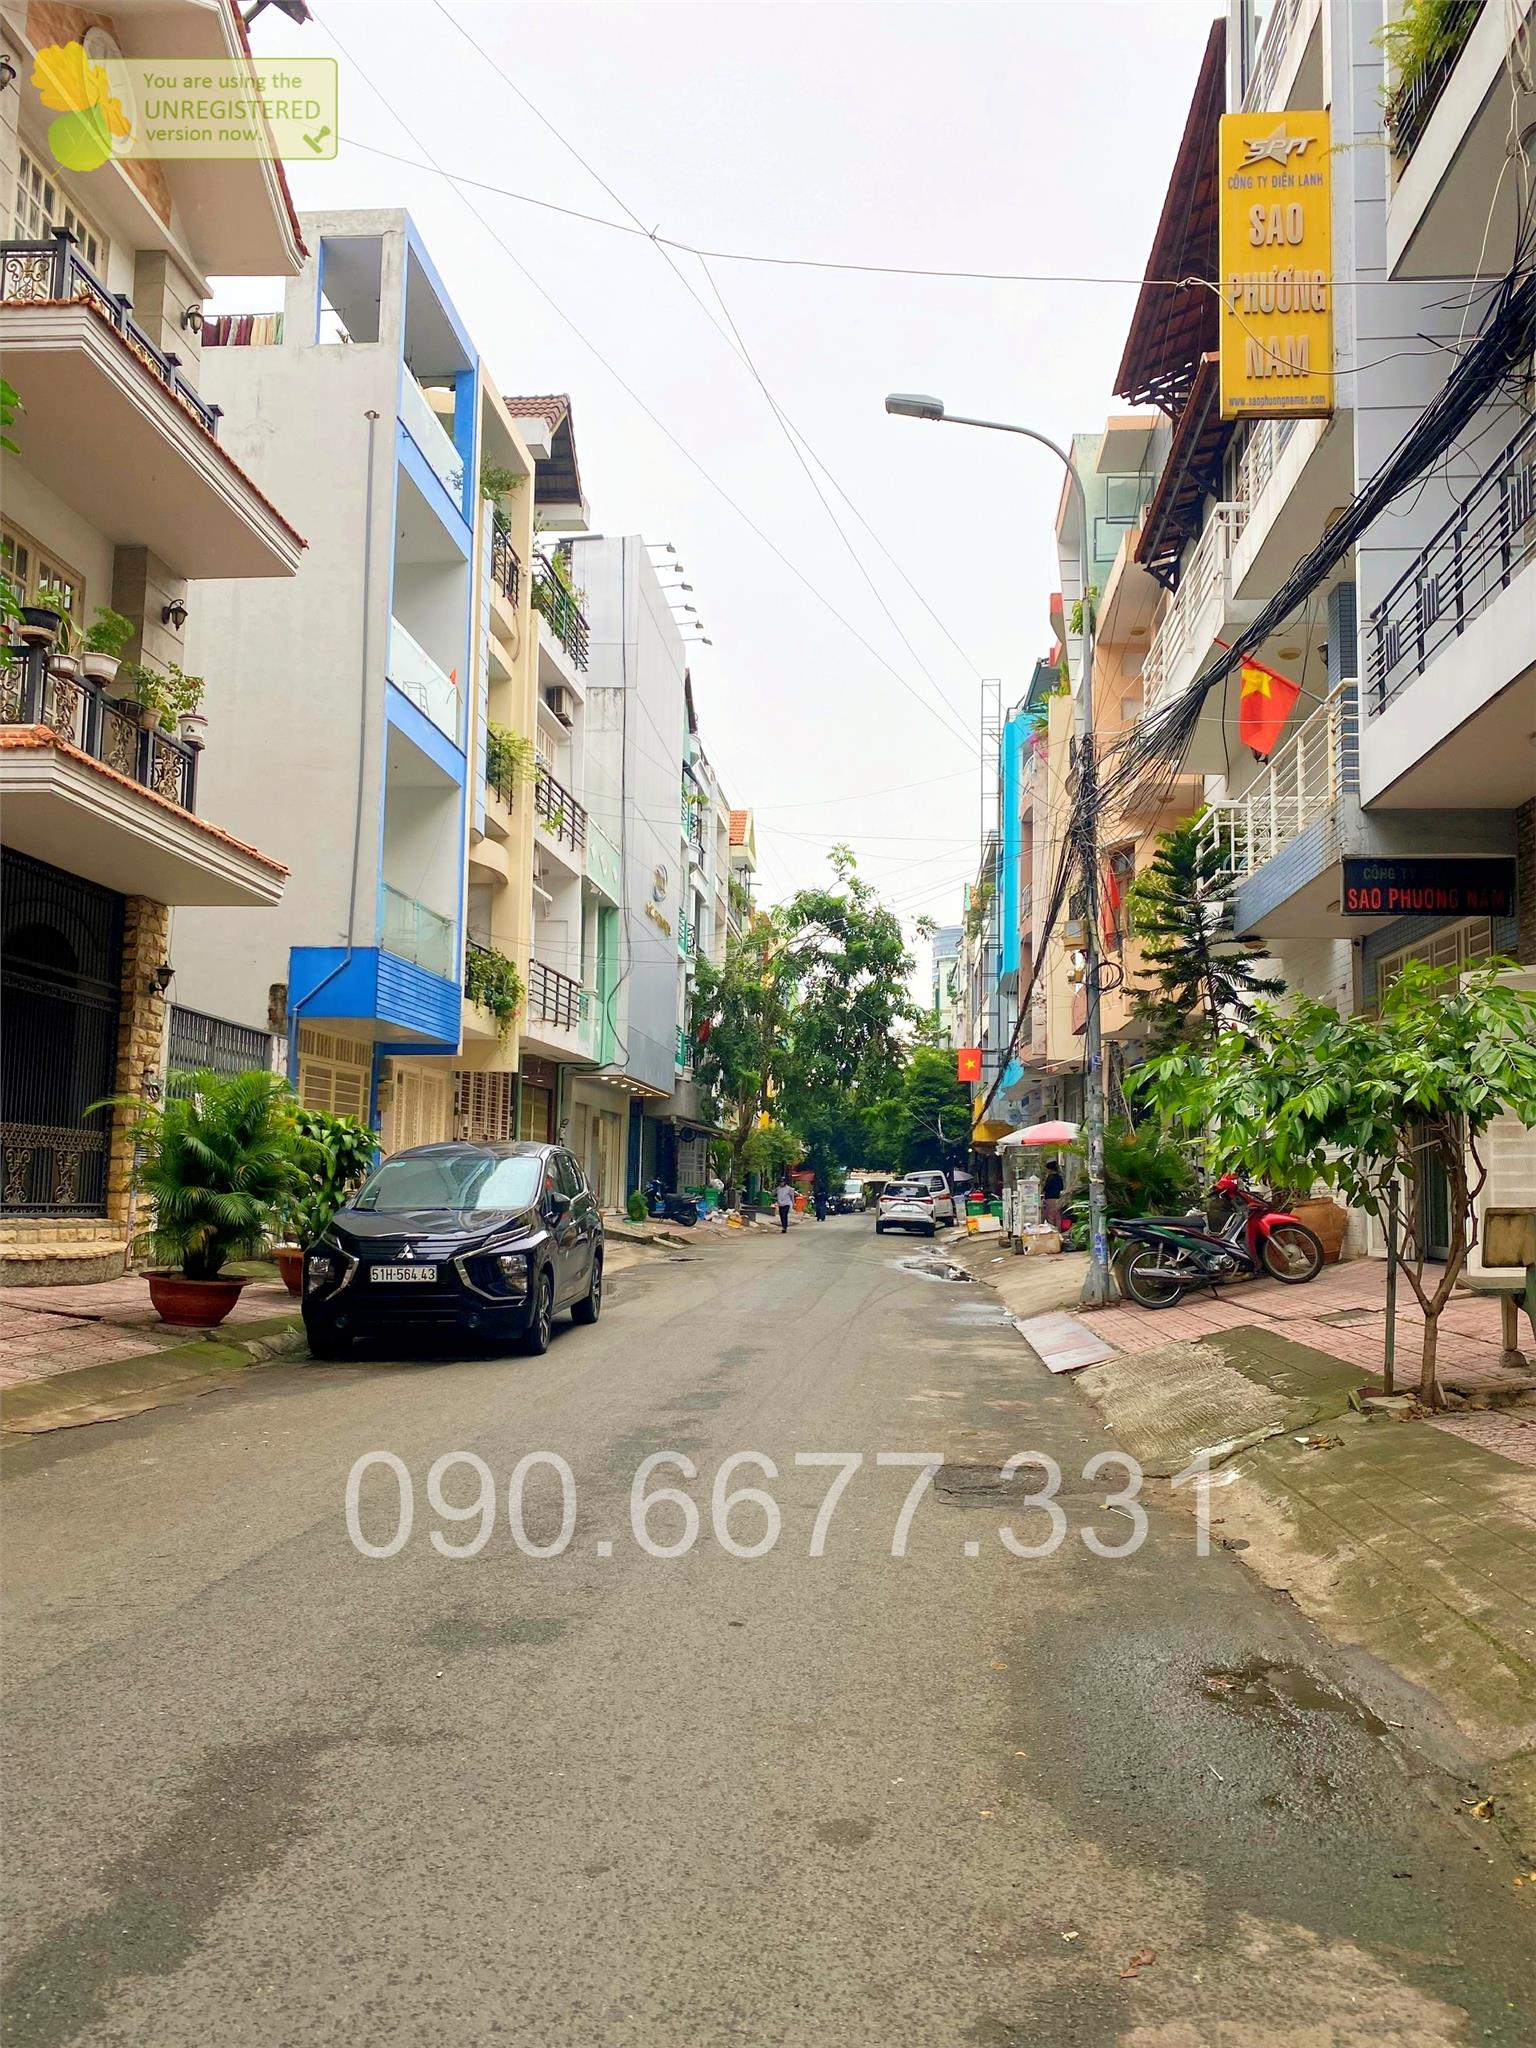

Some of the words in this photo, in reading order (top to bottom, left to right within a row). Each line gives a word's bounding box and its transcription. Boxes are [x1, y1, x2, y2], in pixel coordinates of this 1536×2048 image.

[1228, 173, 1253, 190] CÔNG
[1257, 175, 1268, 189] TY
[1298, 173, 1323, 190] LẠNH
[1249, 202, 1304, 246] SAO
[1228, 264, 1326, 314] PHƯƠNG
[1246, 334, 1310, 379] NAM
[1363, 864, 1396, 880] CÔNG
[1348, 887, 1381, 910] SAO
